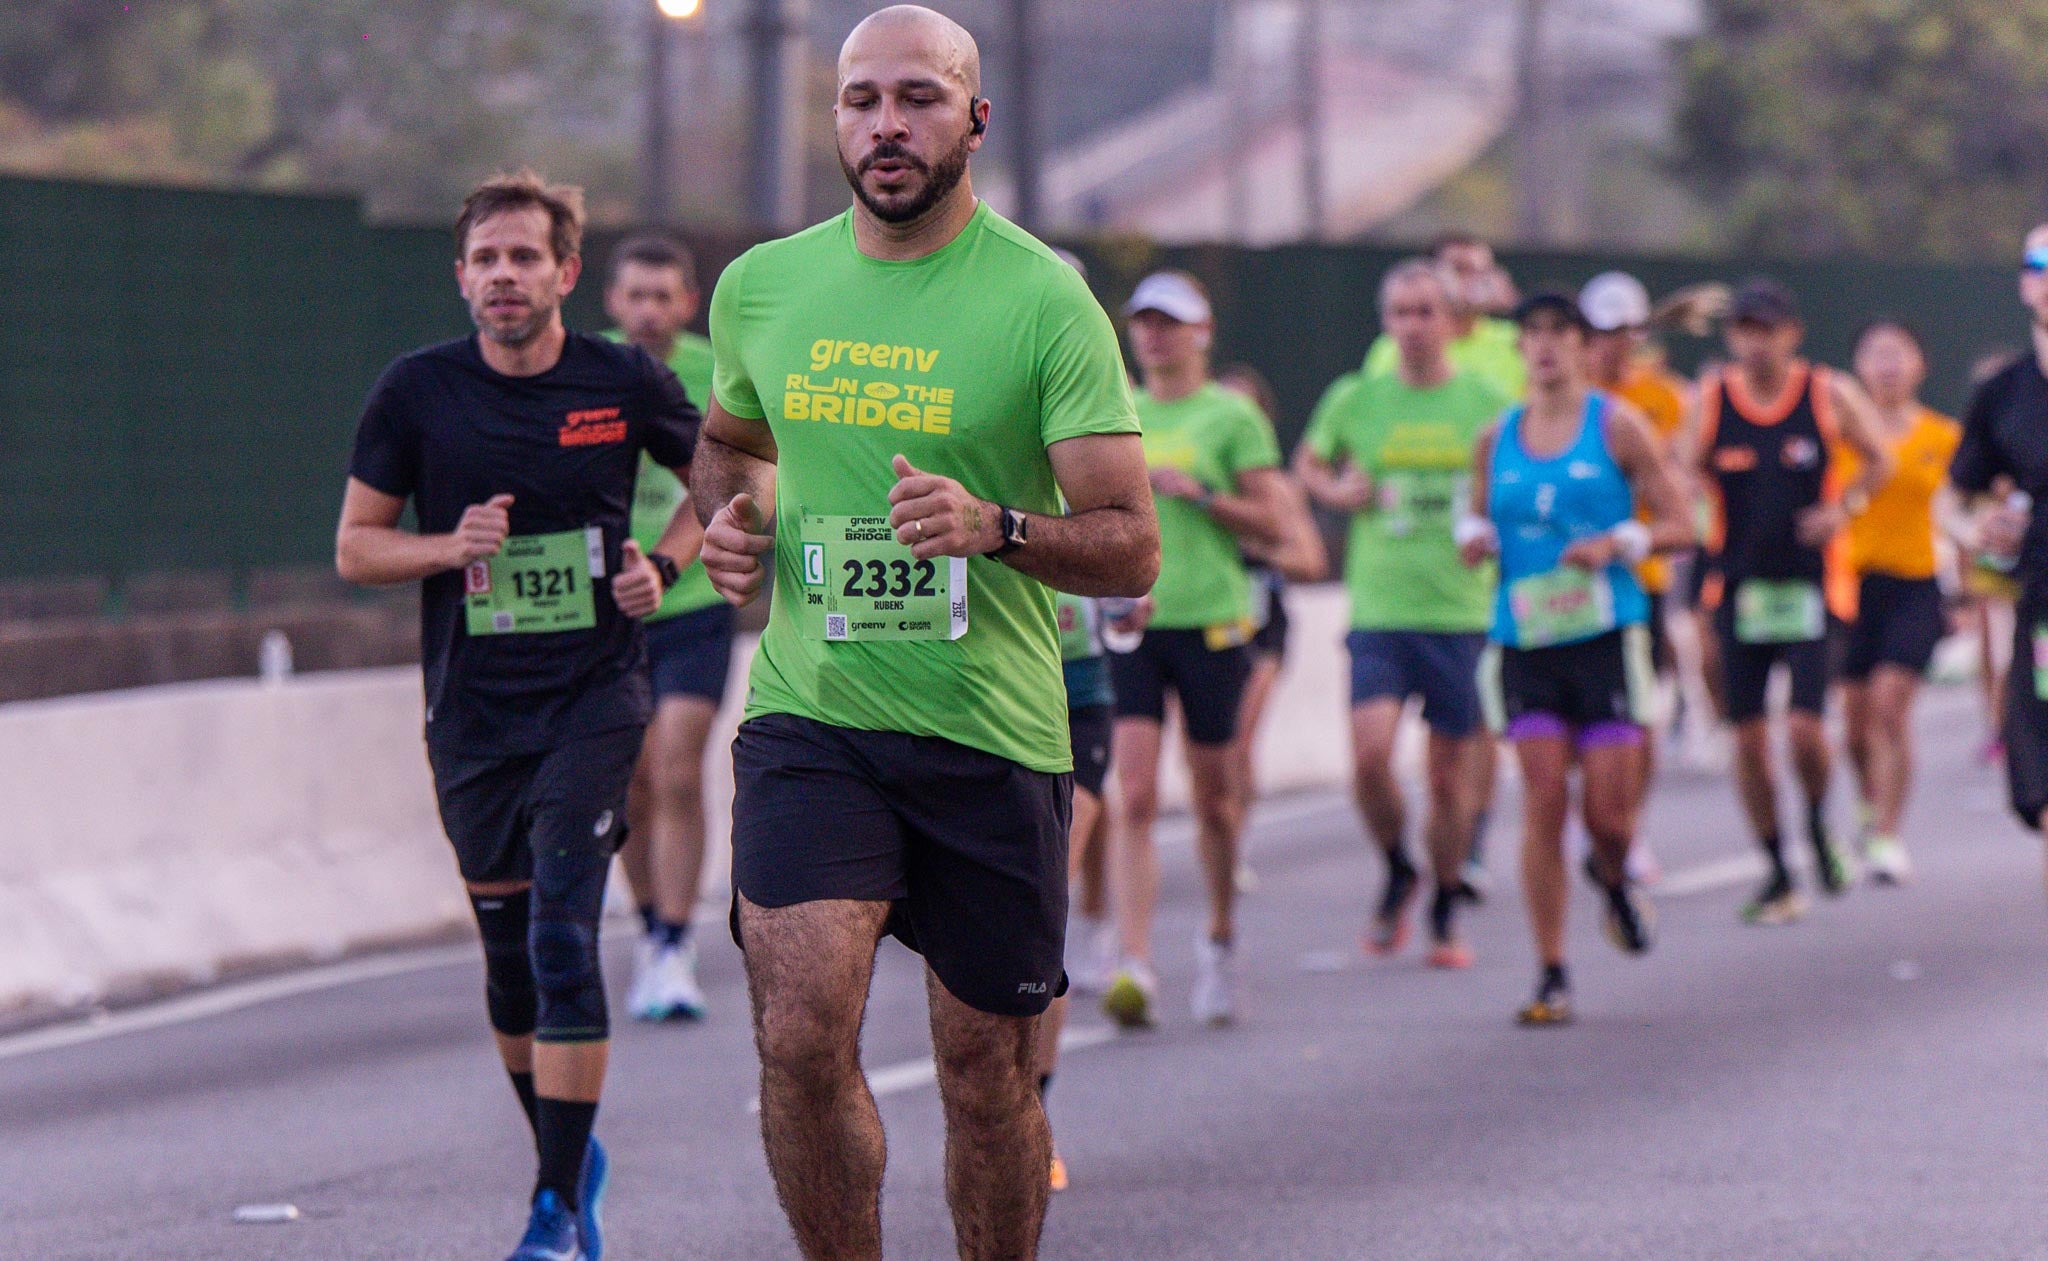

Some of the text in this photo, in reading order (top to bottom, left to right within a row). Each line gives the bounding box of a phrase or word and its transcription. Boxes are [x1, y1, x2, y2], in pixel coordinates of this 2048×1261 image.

[810, 339, 940, 372] greenv
[786, 373, 955, 404] RUN THE
[784, 391, 952, 435] BRIDGE
[851, 517, 886, 527] greenv
[845, 533, 892, 541] BRIDGE
[809, 549, 818, 580] C
[513, 566, 575, 598] 1321
[843, 559, 936, 598] 2332
[807, 593, 823, 605] 30K
[874, 600, 904, 611] RUBENS
[852, 621, 886, 632] greenv
[1017, 982, 1047, 994] FILA
